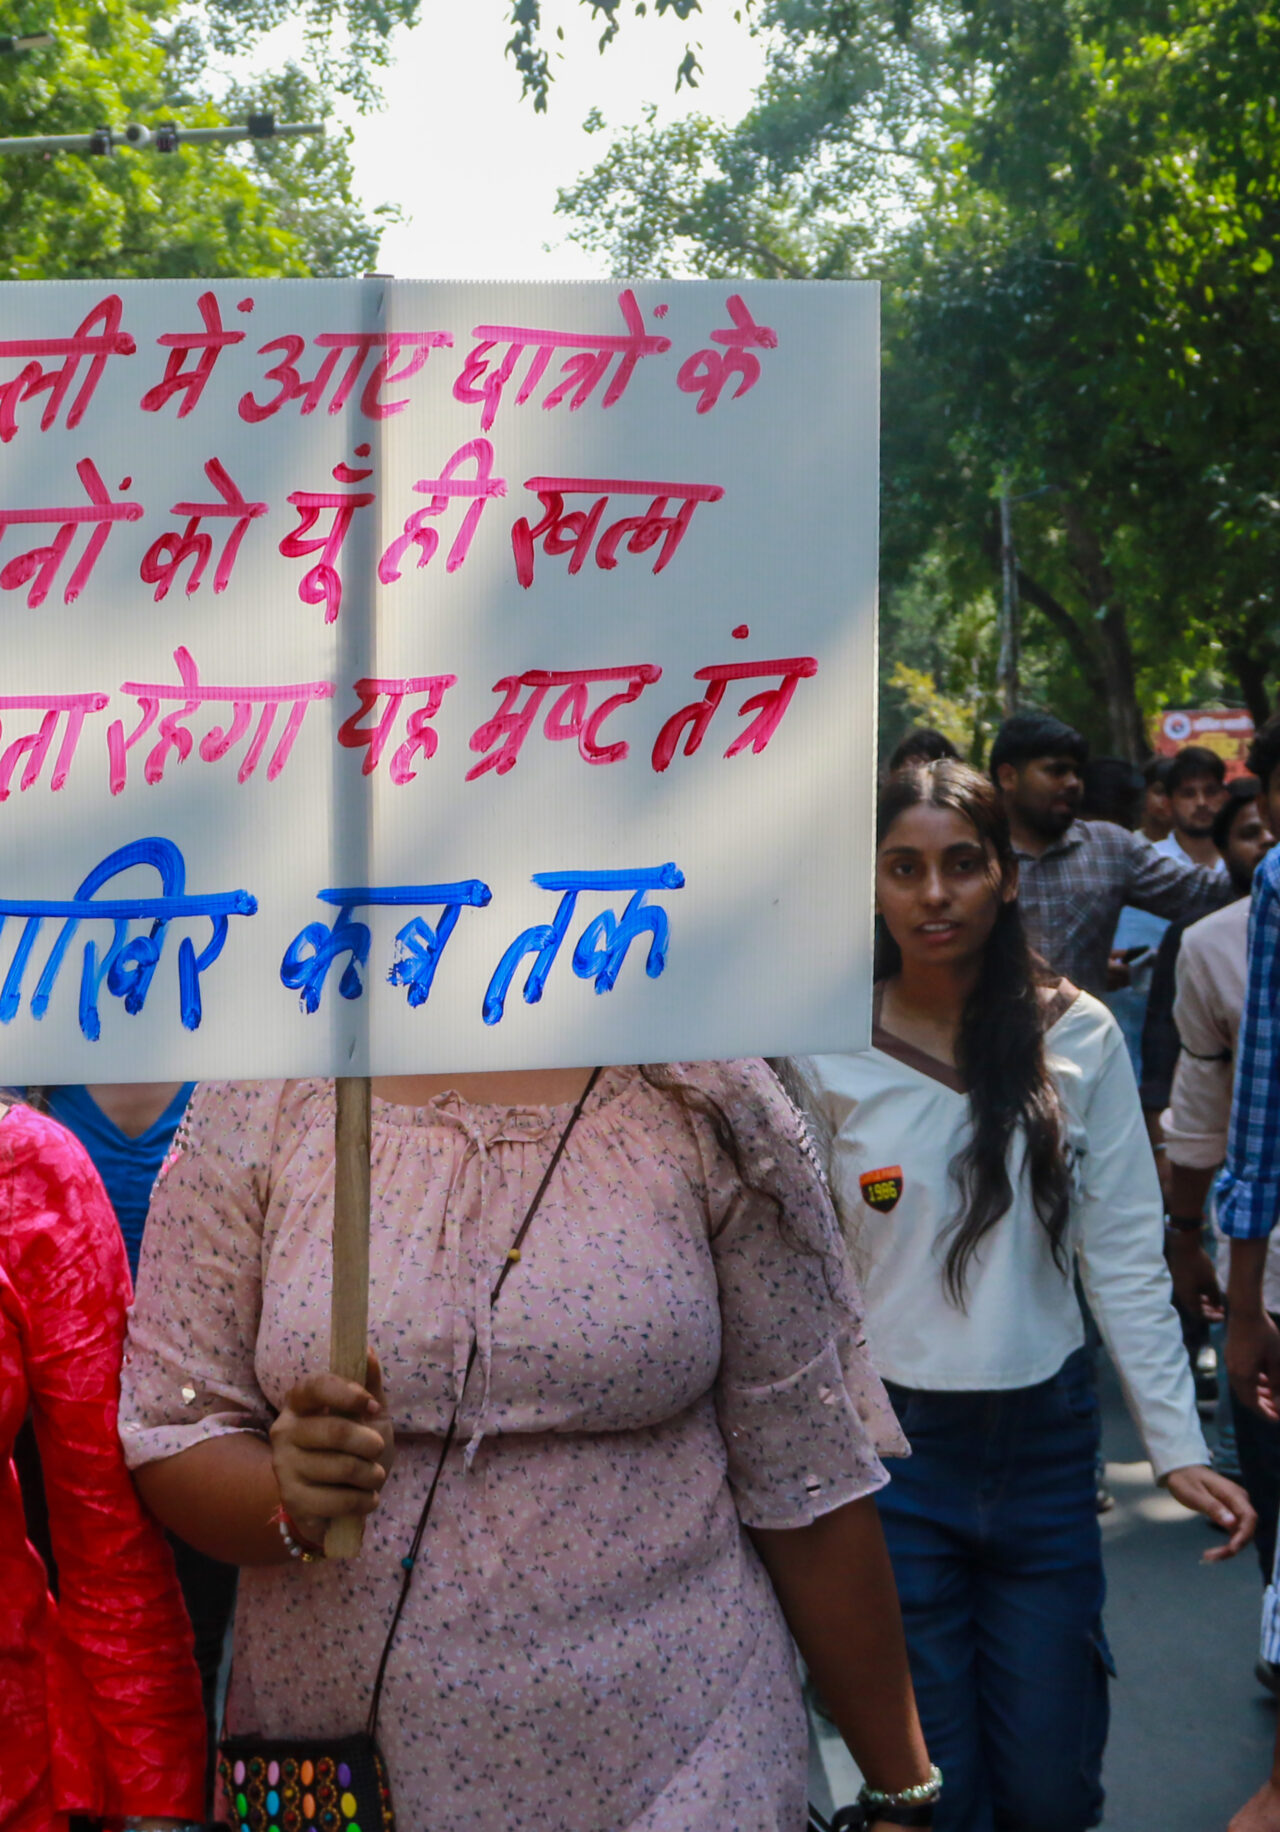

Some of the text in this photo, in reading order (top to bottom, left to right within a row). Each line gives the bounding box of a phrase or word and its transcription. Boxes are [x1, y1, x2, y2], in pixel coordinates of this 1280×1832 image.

[140, 291, 254, 418] में
[237, 331, 454, 423] आए
[677, 295, 777, 414] के
[140, 457, 268, 602] को
[378, 438, 507, 584] ही
[512, 476, 725, 589] खत्म
[107, 646, 336, 796] रहेगा
[338, 674, 458, 785] यह
[465, 664, 662, 782] भ्रष्ट
[652, 624, 818, 772] तंत्र
[281, 880, 492, 1013] कब
[483, 862, 685, 1025] तक
